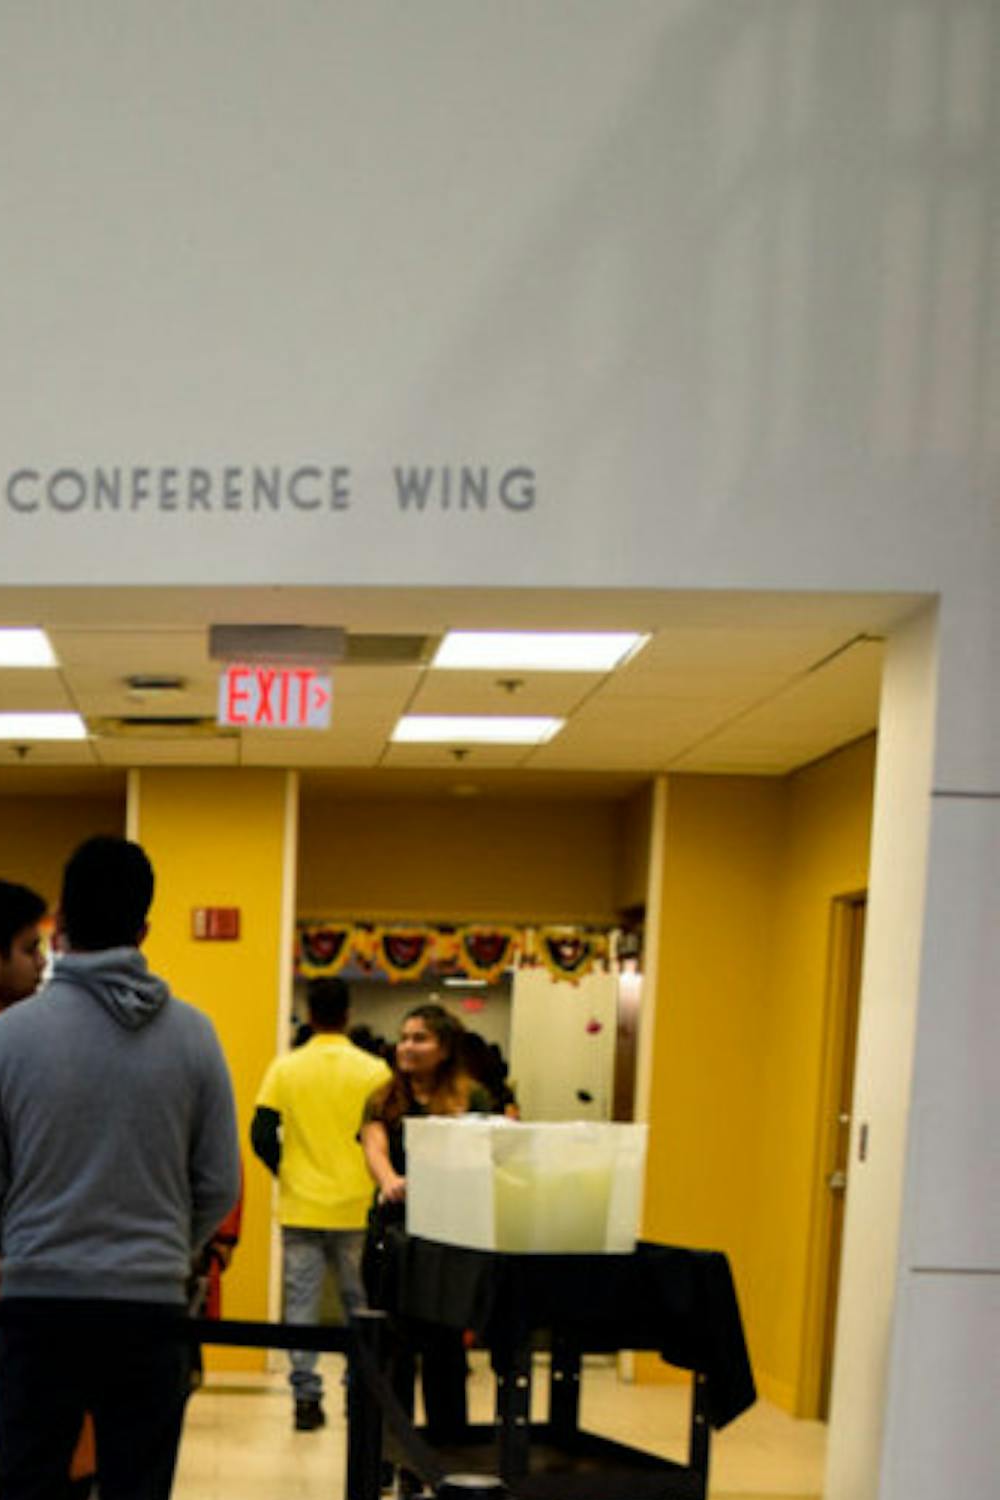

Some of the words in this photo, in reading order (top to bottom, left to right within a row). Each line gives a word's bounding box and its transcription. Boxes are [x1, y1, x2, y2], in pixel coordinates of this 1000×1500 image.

[6, 466, 351, 513] CONFERENCE
[394, 465, 538, 513] WING
[226, 667, 316, 725] EXIT
